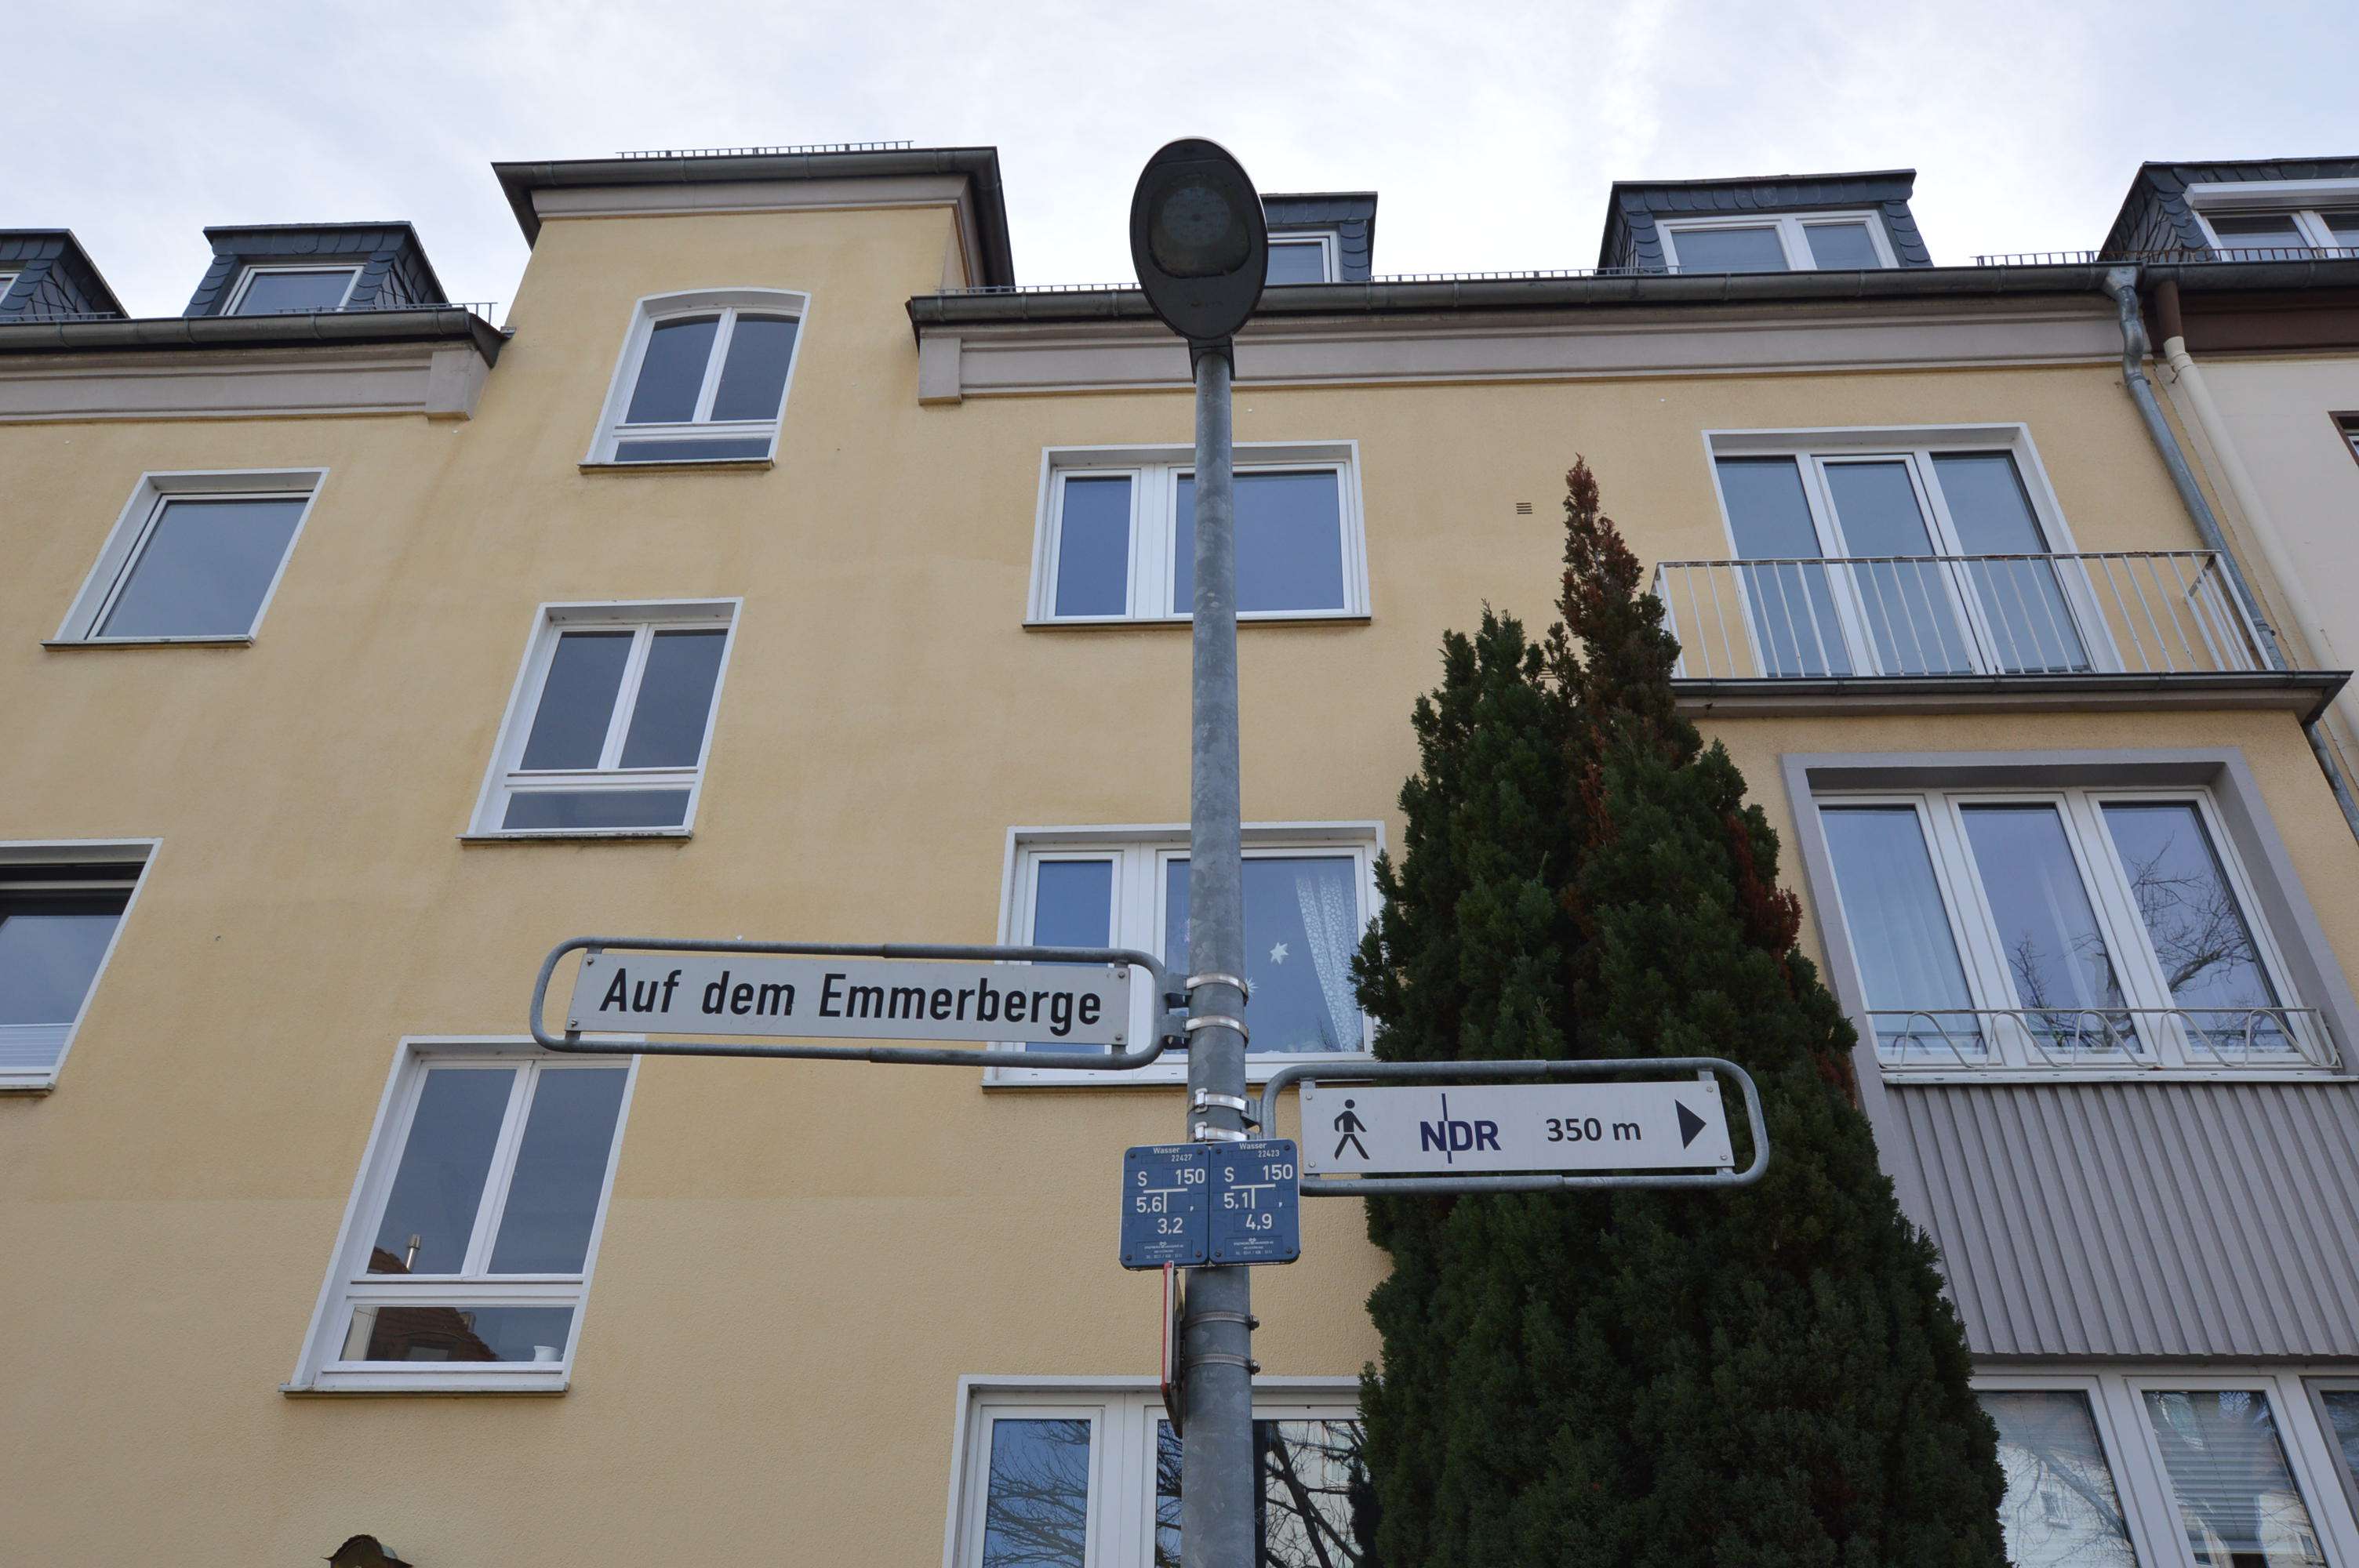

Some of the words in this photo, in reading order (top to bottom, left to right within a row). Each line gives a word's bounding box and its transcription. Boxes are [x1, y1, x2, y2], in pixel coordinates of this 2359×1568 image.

[600, 967, 682, 1012] Auf
[702, 971, 795, 1016] dem
[820, 973, 1102, 1036] Emmerberge
[1420, 1120, 1502, 1152] NDR
[1546, 1117, 1602, 1143] 350
[1613, 1122, 1642, 1142] m
[1258, 1149, 1280, 1158] 22423
[1137, 1171, 1147, 1187] S
[1176, 1168, 1205, 1185] 150
[1224, 1167, 1234, 1182] S
[1263, 1163, 1293, 1181] 150
[1136, 1196, 1161, 1214] 5,6
[1223, 1192, 1248, 1209] 5,1
[1157, 1218, 1183, 1235] 3,2
[1245, 1213, 1272, 1231] 4,9
